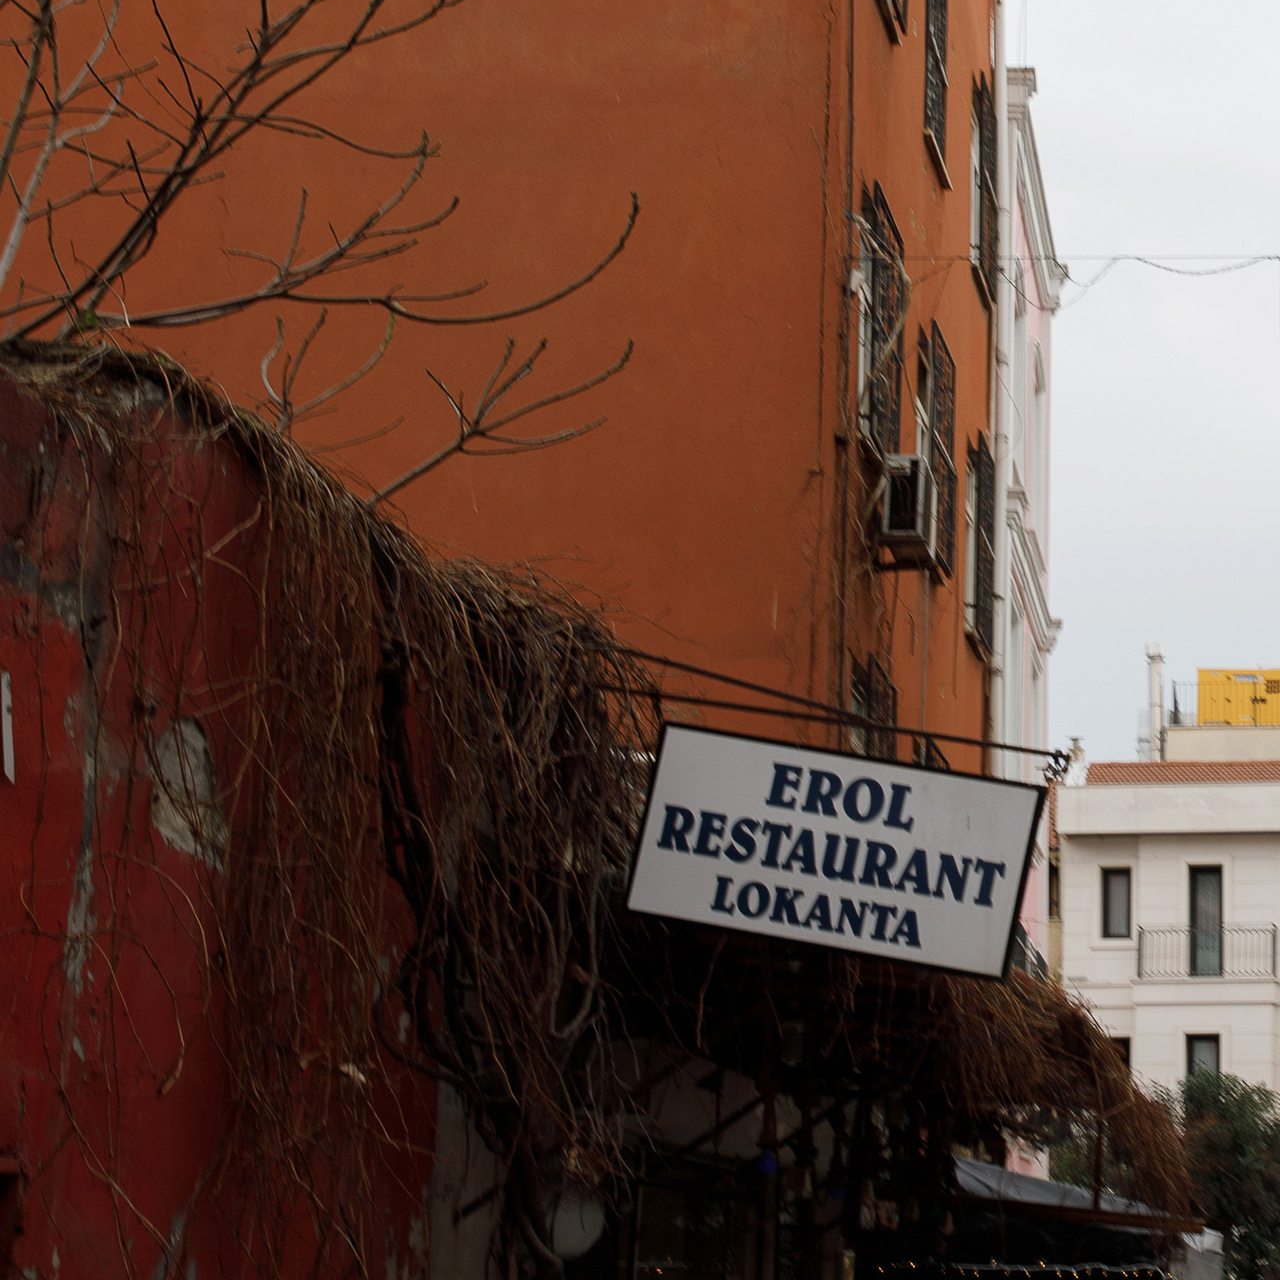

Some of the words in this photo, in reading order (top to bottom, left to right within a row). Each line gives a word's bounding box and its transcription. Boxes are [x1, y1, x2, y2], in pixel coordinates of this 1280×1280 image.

[766, 762, 914, 833] EROL
[657, 803, 1006, 908] RESTAURANT
[710, 875, 922, 949] LOKANTA
